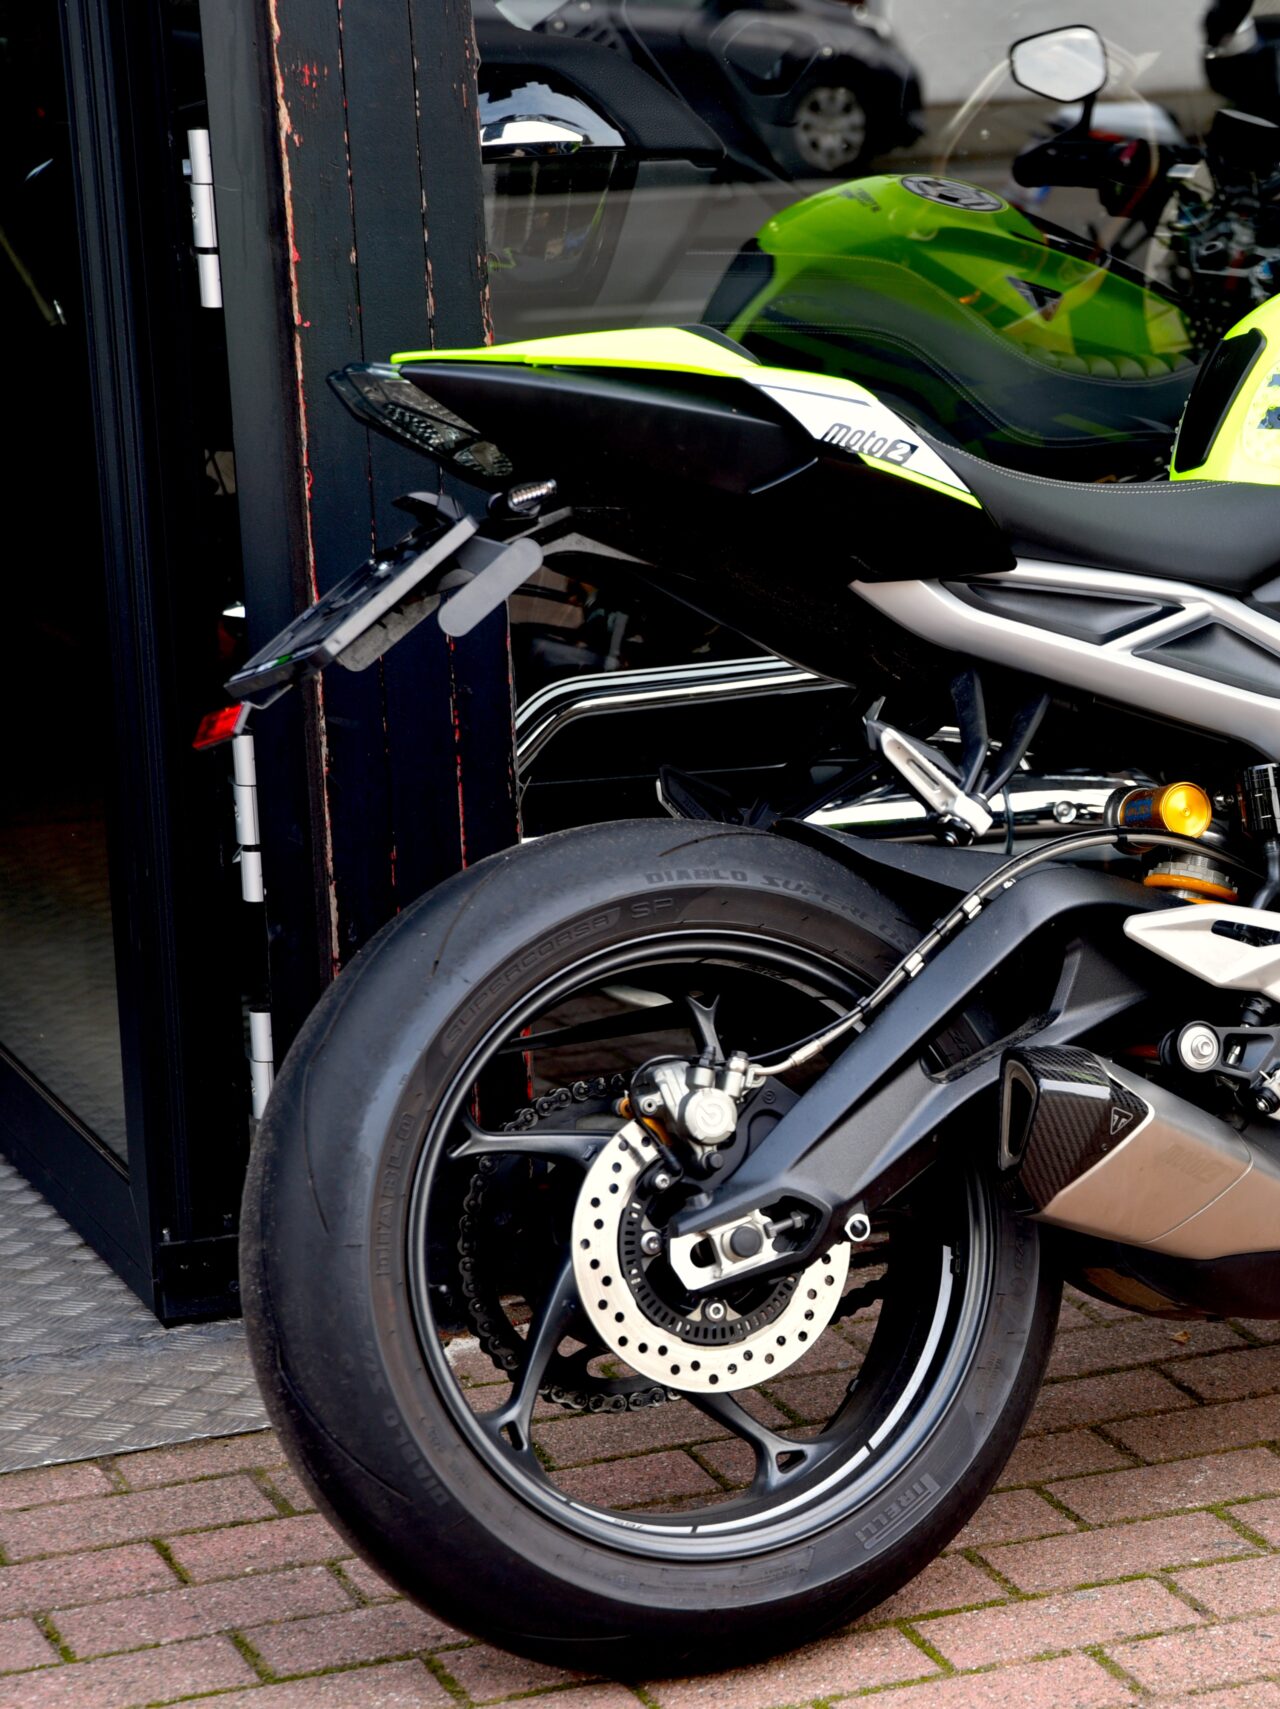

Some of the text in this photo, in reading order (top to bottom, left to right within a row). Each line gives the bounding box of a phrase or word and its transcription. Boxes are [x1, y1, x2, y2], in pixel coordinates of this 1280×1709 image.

[645, 868, 749, 887] DIABLO
[446, 897, 674, 1047] SUPERCORSA SP
[855, 1472, 942, 1549] PIRELLI
